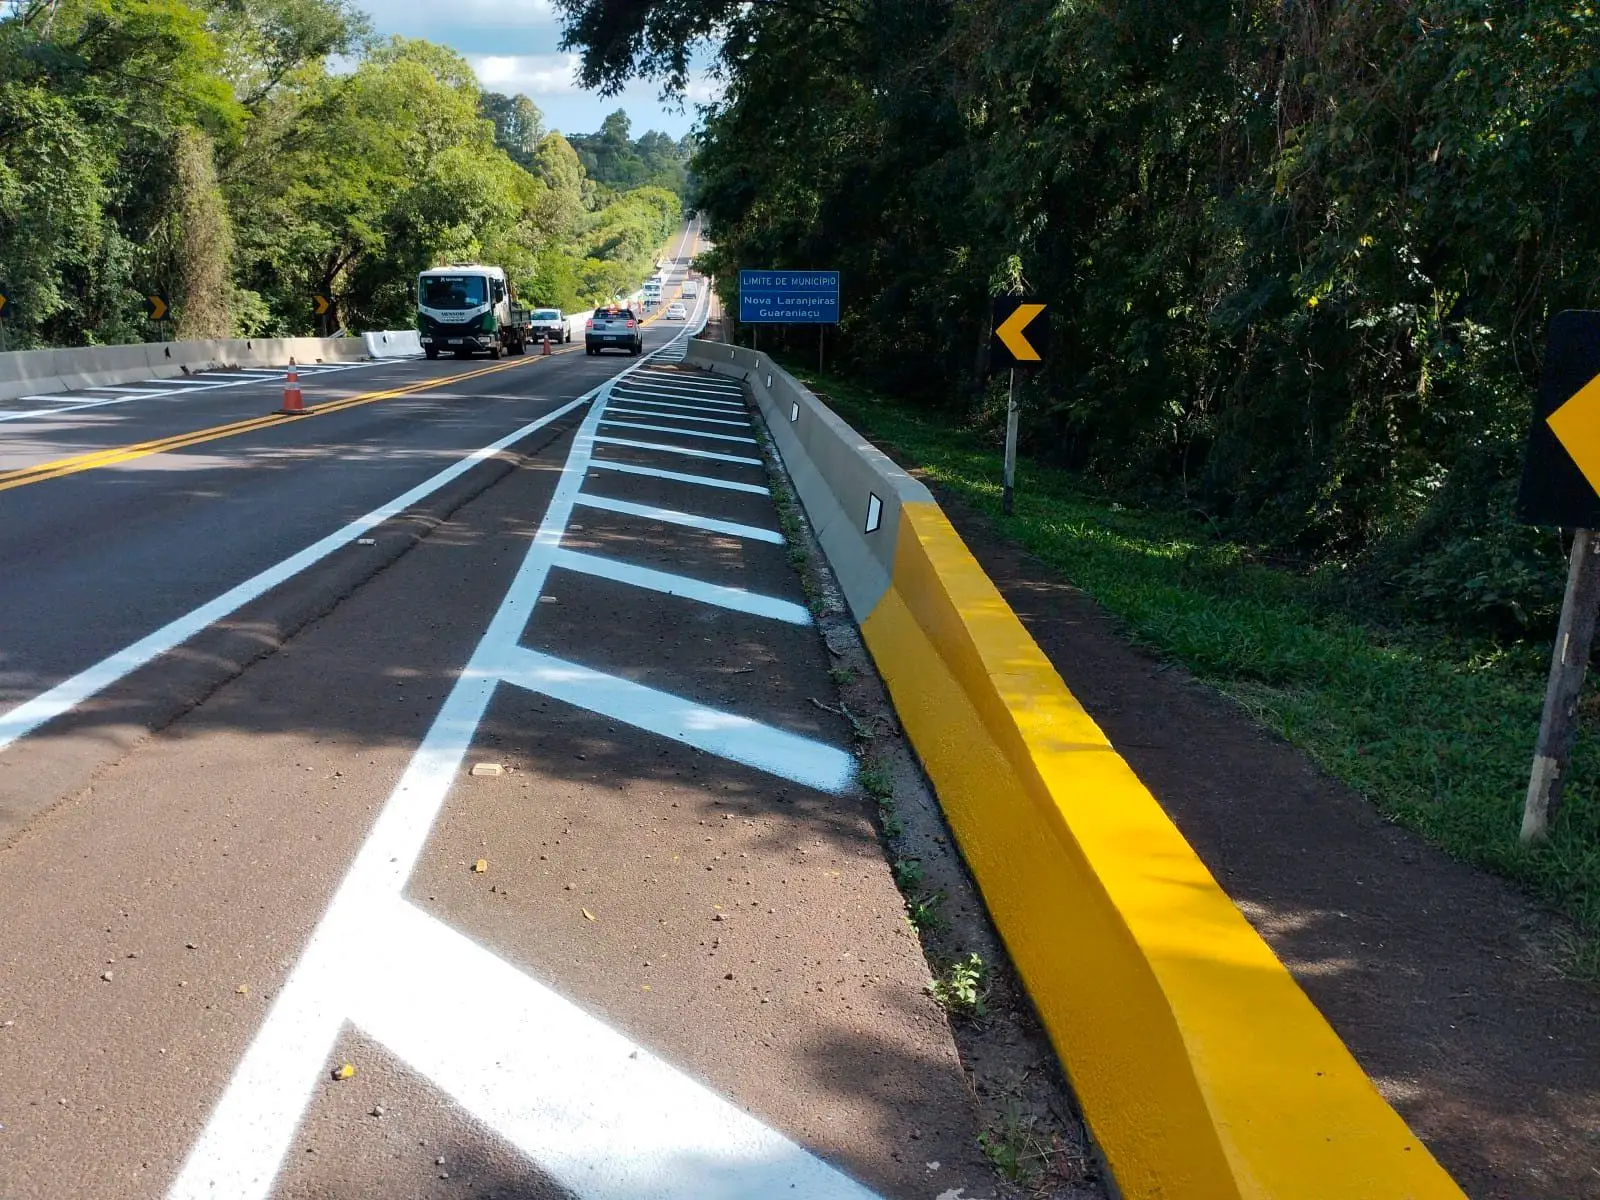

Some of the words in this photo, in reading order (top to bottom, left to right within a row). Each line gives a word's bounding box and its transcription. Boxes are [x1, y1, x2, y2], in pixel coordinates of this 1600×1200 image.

[743, 277, 772, 286] LIMITE
[775, 277, 788, 286] DE
[744, 296, 771, 305] Nova
[777, 296, 835, 306] Laranjeiras
[759, 309, 820, 318] Guaraniaçu
